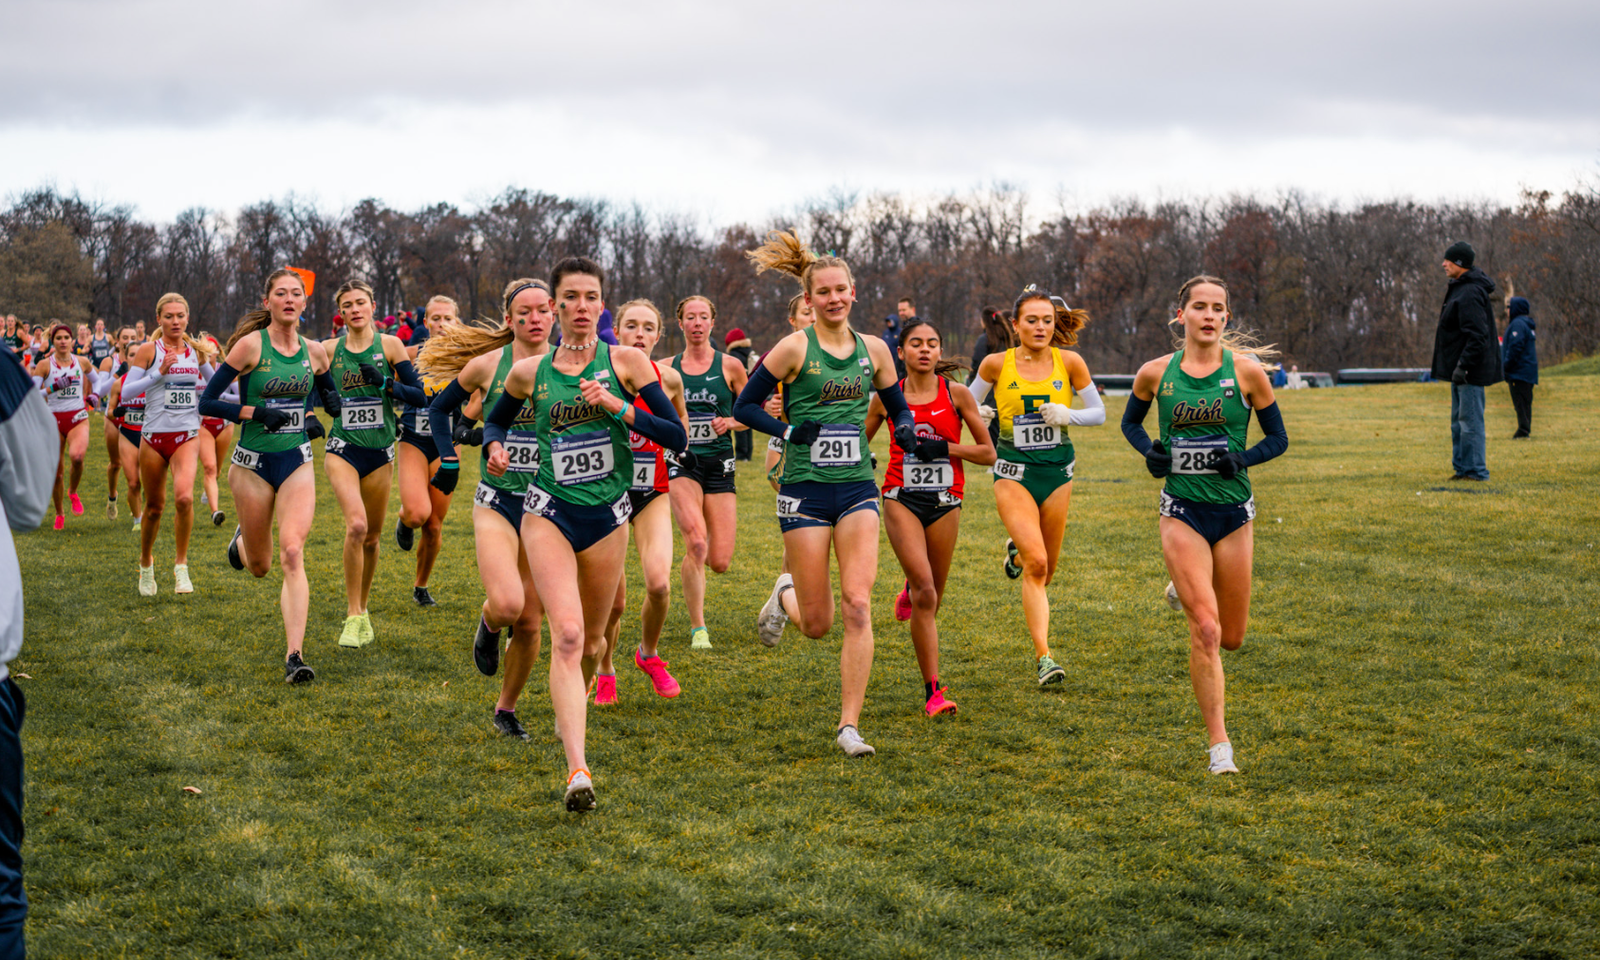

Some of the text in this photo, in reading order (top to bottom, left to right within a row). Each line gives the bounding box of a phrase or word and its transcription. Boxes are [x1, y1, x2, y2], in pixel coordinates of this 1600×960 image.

[60, 387, 77, 396] 382
[262, 374, 310, 395] Irish
[820, 374, 864, 400] Irish
[170, 391, 192, 404] 386
[537, 391, 549, 399] ACC
[684, 388, 719, 405] tate
[284, 411, 299, 427] 90
[348, 408, 377, 424] 283
[550, 395, 607, 426] Irish
[1172, 398, 1227, 424] Irish
[689, 424, 711, 438] 73
[1021, 426, 1054, 443] 180
[326, 437, 340, 449] 83
[819, 440, 851, 459] 291
[232, 449, 252, 466] 290
[507, 445, 540, 465] 284
[561, 450, 605, 476] 293
[911, 467, 943, 484] 321
[997, 462, 1018, 477] 180
[525, 490, 541, 510] 93
[778, 499, 793, 514] 291
